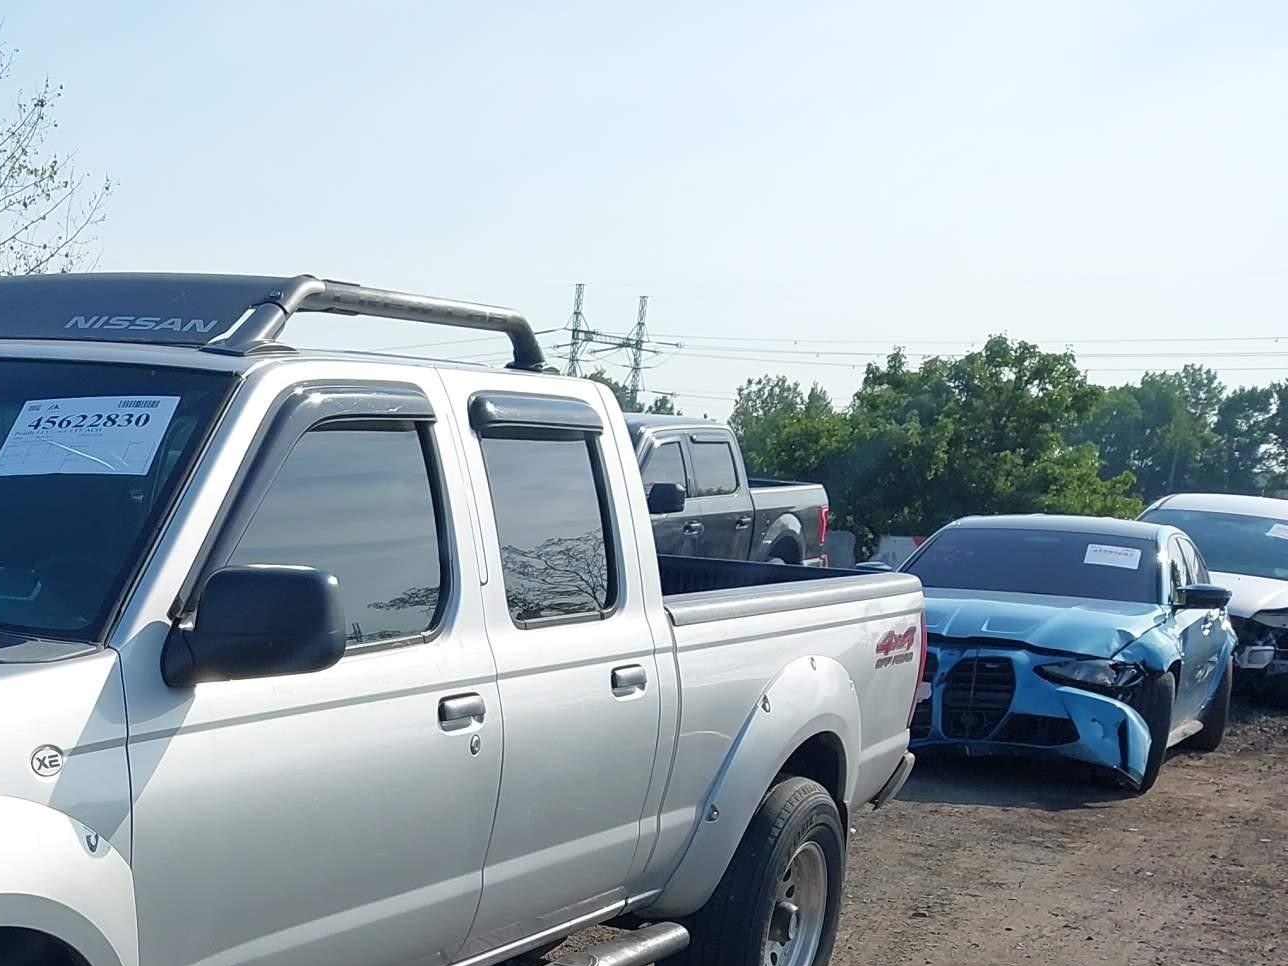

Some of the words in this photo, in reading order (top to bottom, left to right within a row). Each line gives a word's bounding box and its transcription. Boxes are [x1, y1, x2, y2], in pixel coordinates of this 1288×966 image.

[64, 315, 218, 333] NISSAN
[27, 412, 152, 430] 45622830
[35, 754, 61, 770] XE
